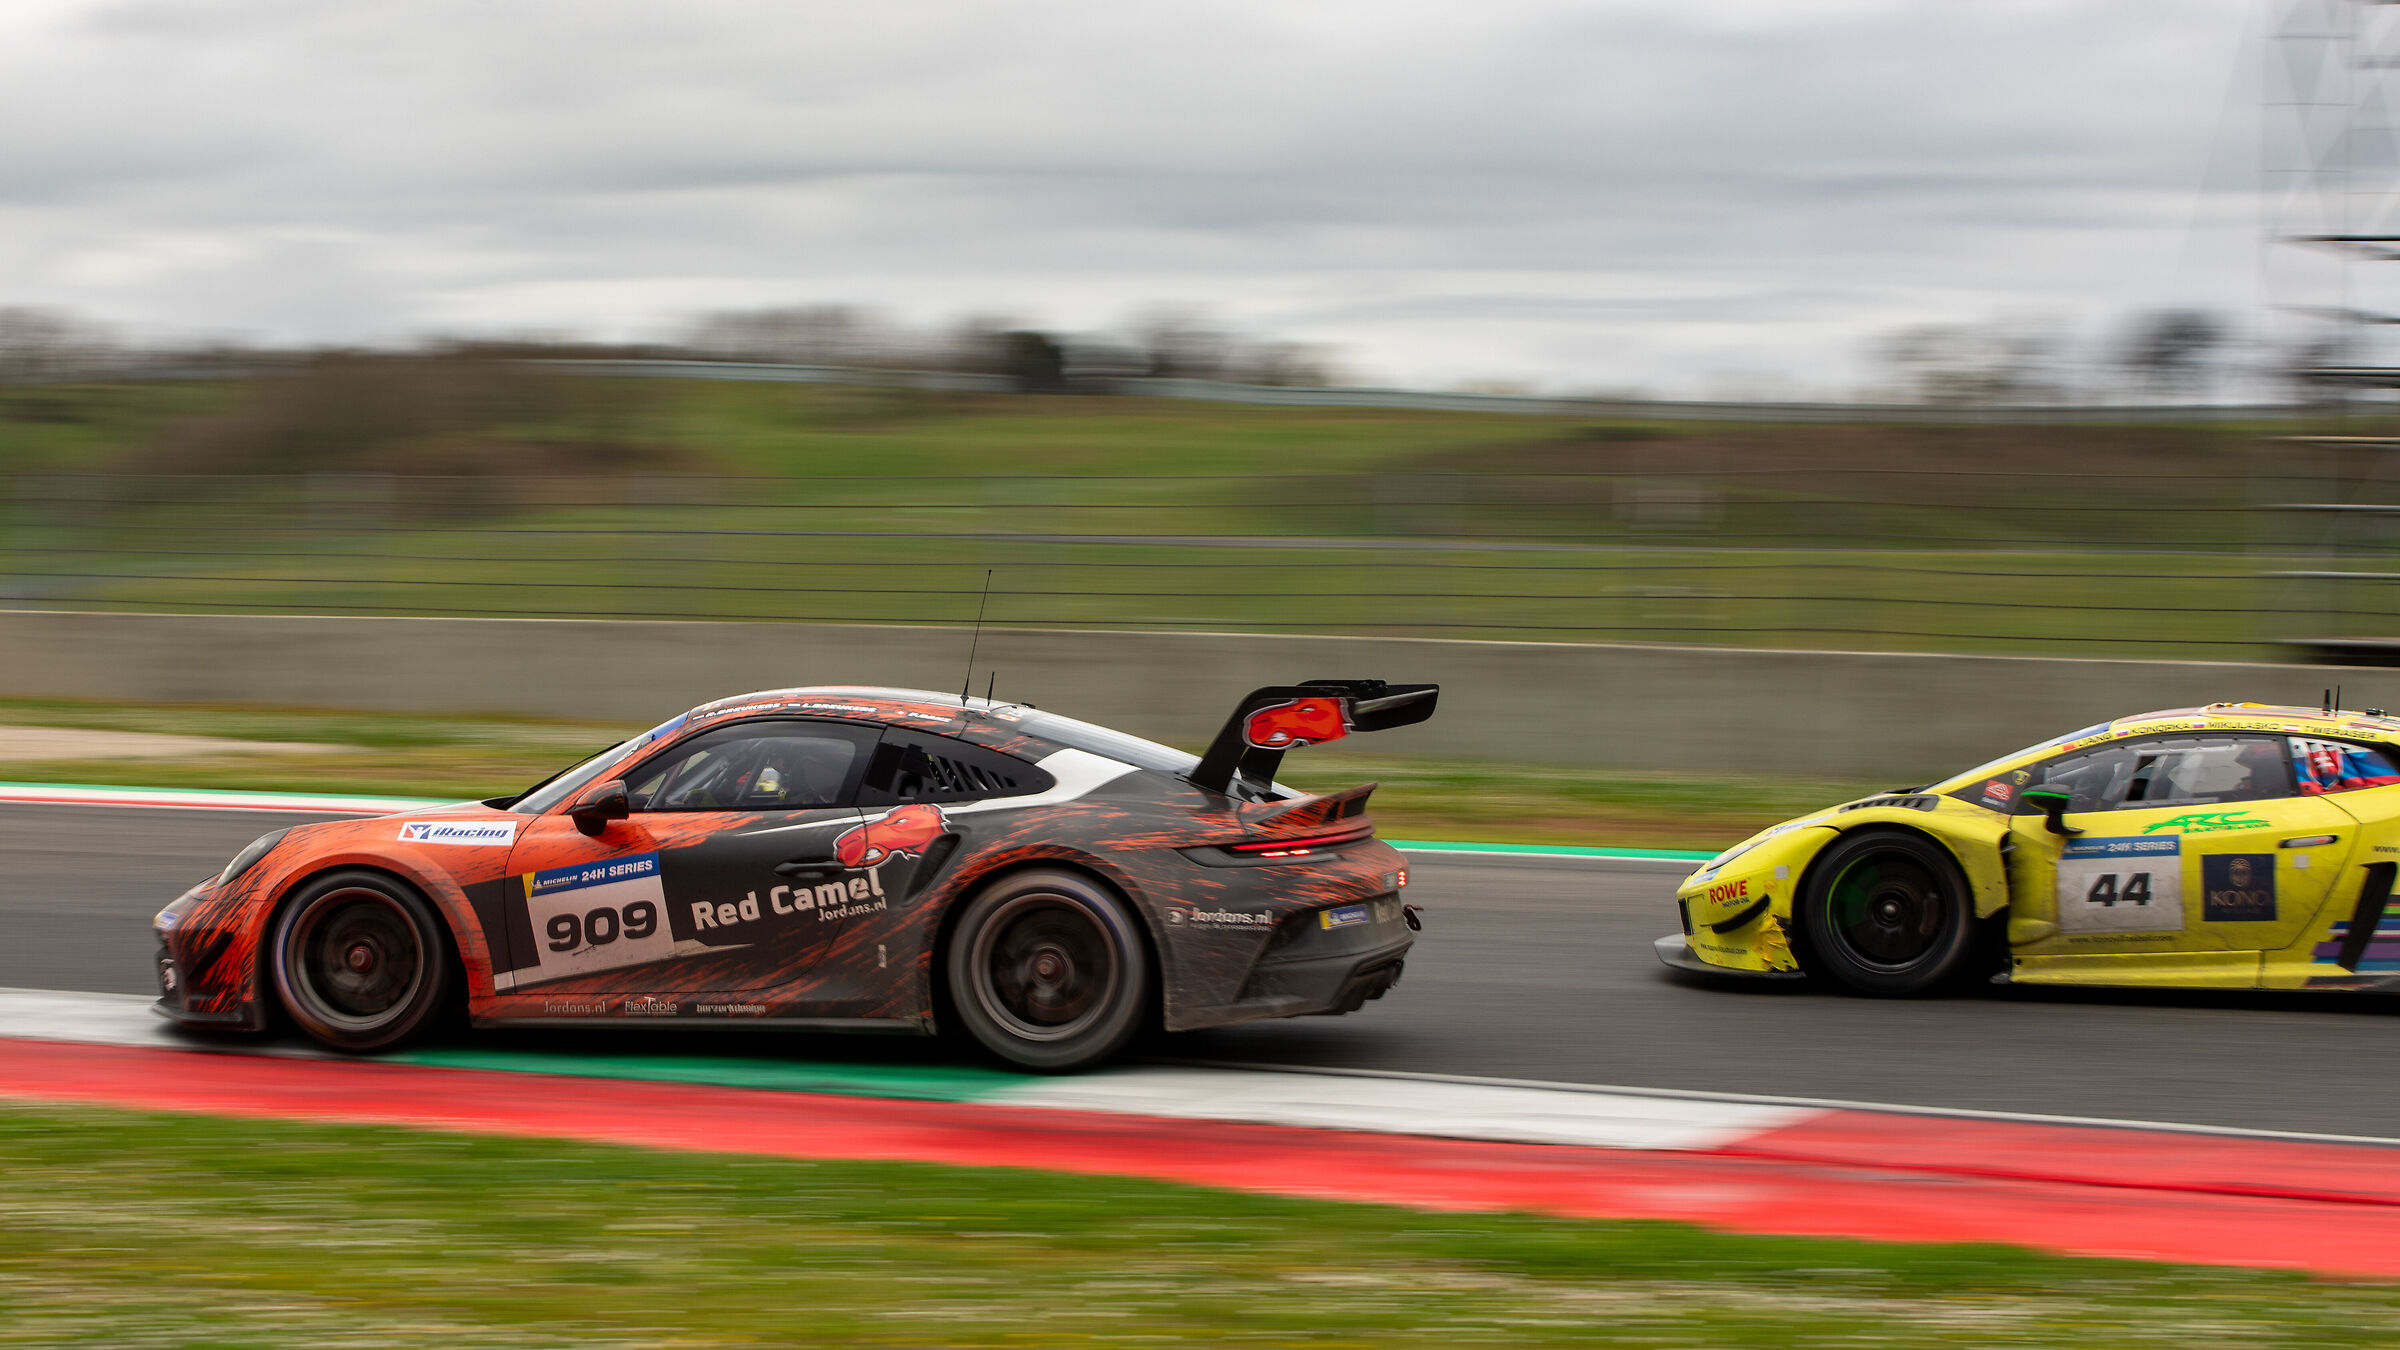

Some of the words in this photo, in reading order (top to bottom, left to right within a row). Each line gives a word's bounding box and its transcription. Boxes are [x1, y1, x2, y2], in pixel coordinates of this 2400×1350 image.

[432, 827, 509, 838] iRacing
[2142, 811, 2271, 834] ARC
[2107, 843, 2133, 852] 24H
[2134, 841, 2177, 851] SERIES
[543, 874, 579, 886] MICHELIN
[581, 870, 605, 882] 24H
[608, 859, 653, 877] SERIES
[690, 890, 761, 931] Red
[769, 867, 885, 915] Camel
[1709, 880, 1748, 904] ROWE
[2086, 872, 2152, 907] 44
[2210, 890, 2270, 907] KONO
[818, 896, 887, 922] Jordans.nl
[1190, 907, 1273, 925] Jordans.nl
[546, 900, 658, 952] 909
[543, 1001, 606, 1013] Jordans.nl
[624, 996, 677, 1014] FlexTable
